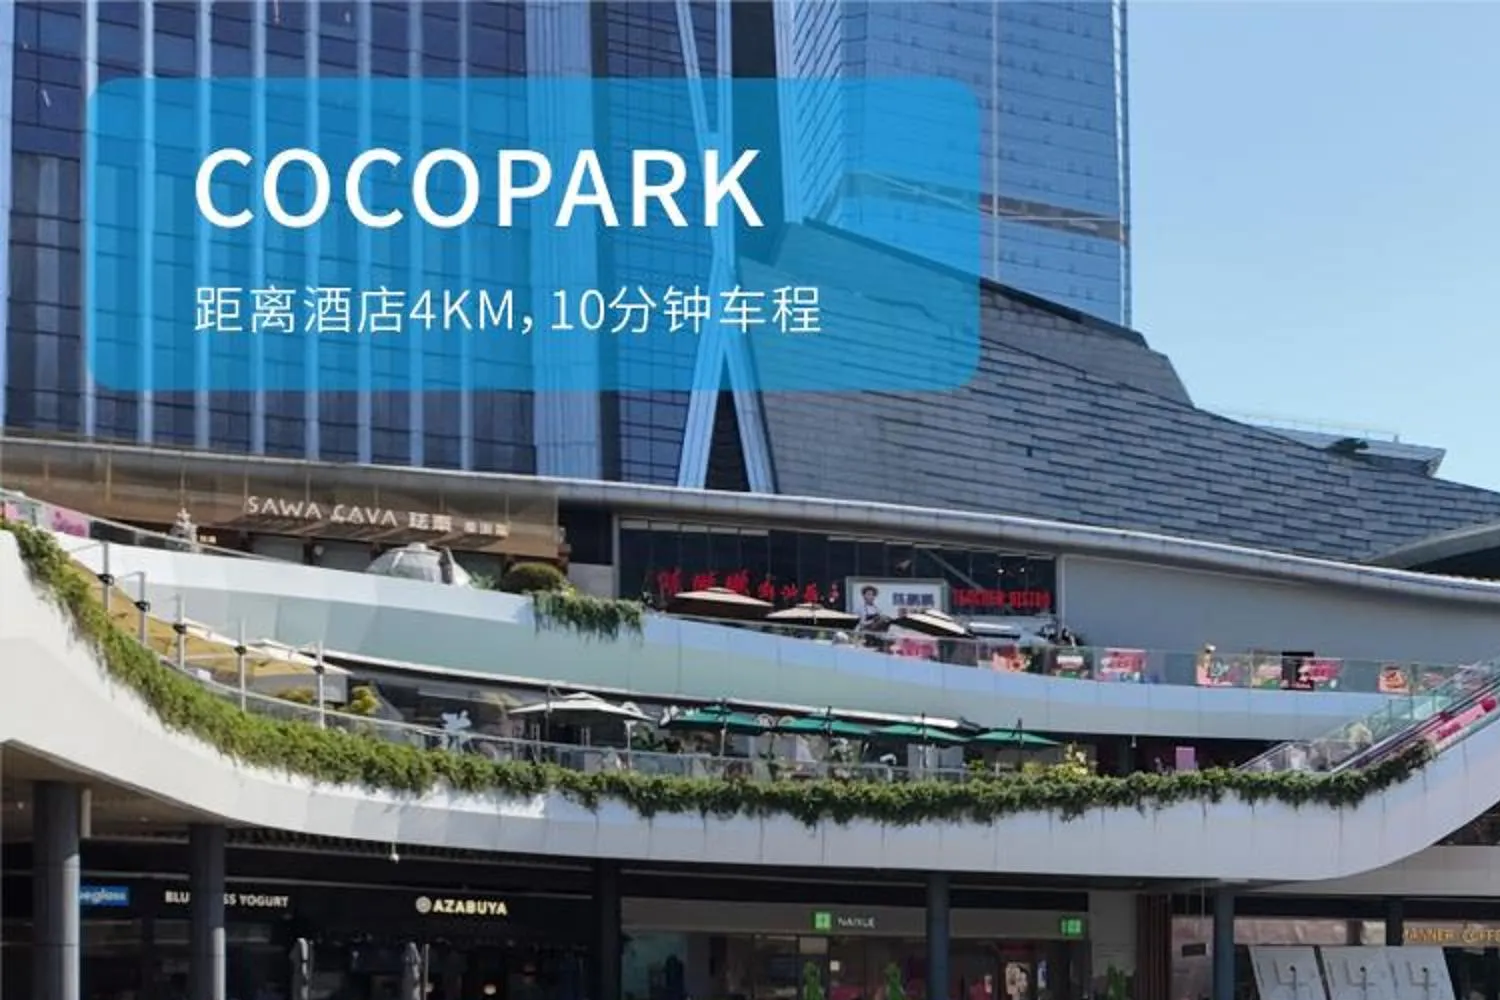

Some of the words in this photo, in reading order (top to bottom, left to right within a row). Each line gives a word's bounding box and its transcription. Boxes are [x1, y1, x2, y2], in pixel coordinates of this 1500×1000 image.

[247, 495, 322, 520] SAWA
[239, 894, 289, 907] YOGURT
[432, 899, 508, 916] AZABUYA
